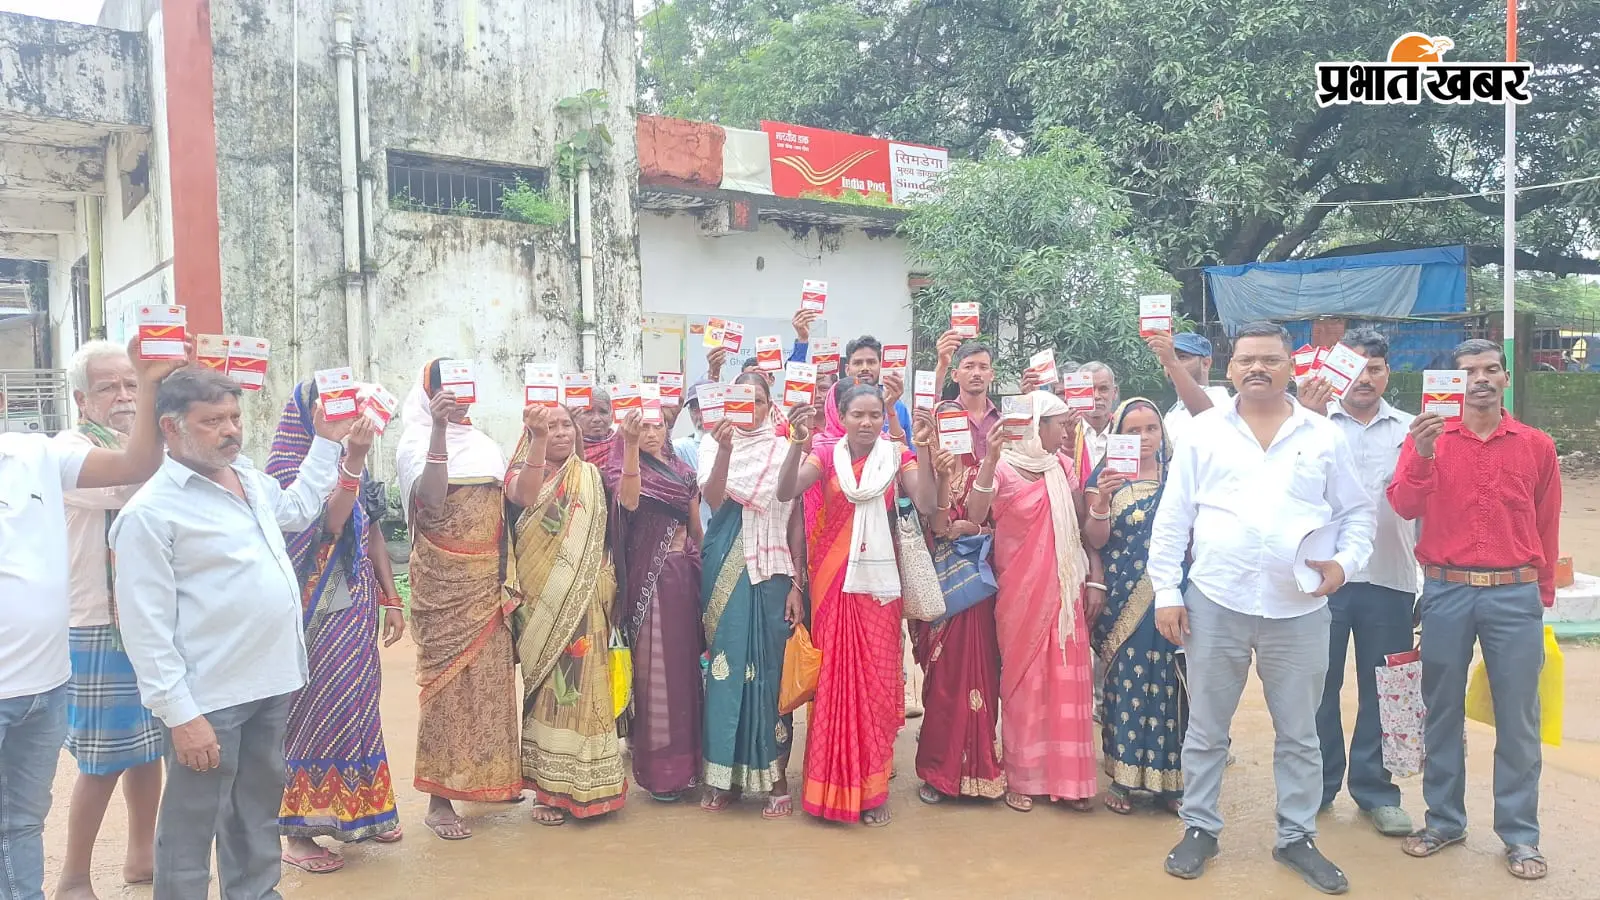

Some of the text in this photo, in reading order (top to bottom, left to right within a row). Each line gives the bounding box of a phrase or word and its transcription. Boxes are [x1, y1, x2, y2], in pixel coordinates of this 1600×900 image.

[896, 150, 943, 169] सिमडेगा
[897, 166, 914, 177] मुख्य
[842, 176, 886, 193] India Post
